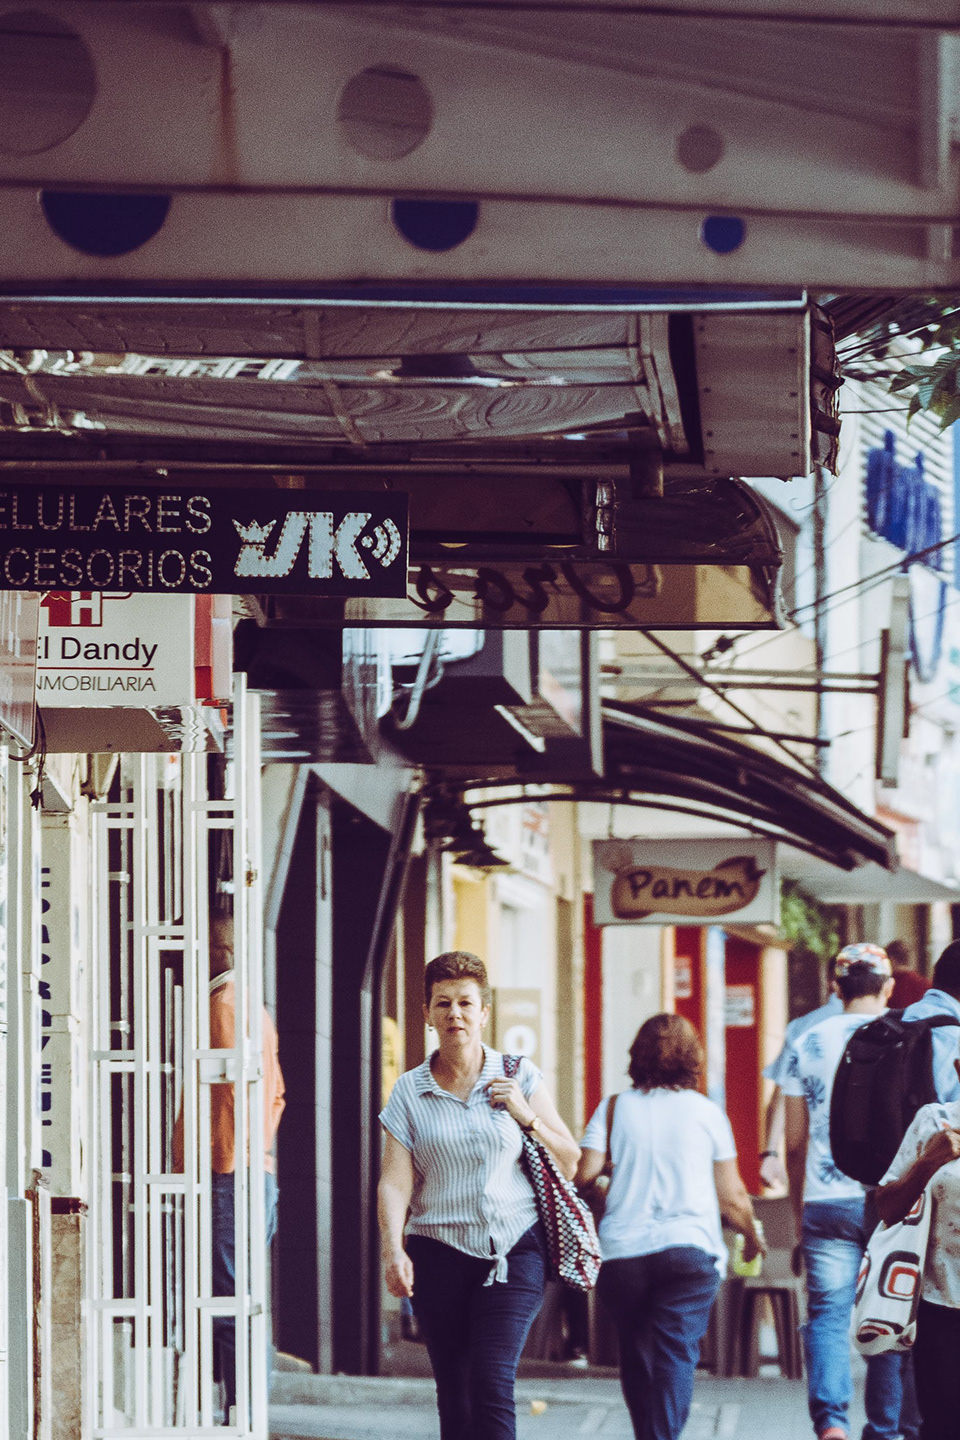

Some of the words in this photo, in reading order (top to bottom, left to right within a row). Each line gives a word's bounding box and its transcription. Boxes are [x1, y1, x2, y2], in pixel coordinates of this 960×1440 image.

[38, 636, 49, 659] l
[61, 637, 158, 668] Dandy
[627, 870, 747, 899] Panem
